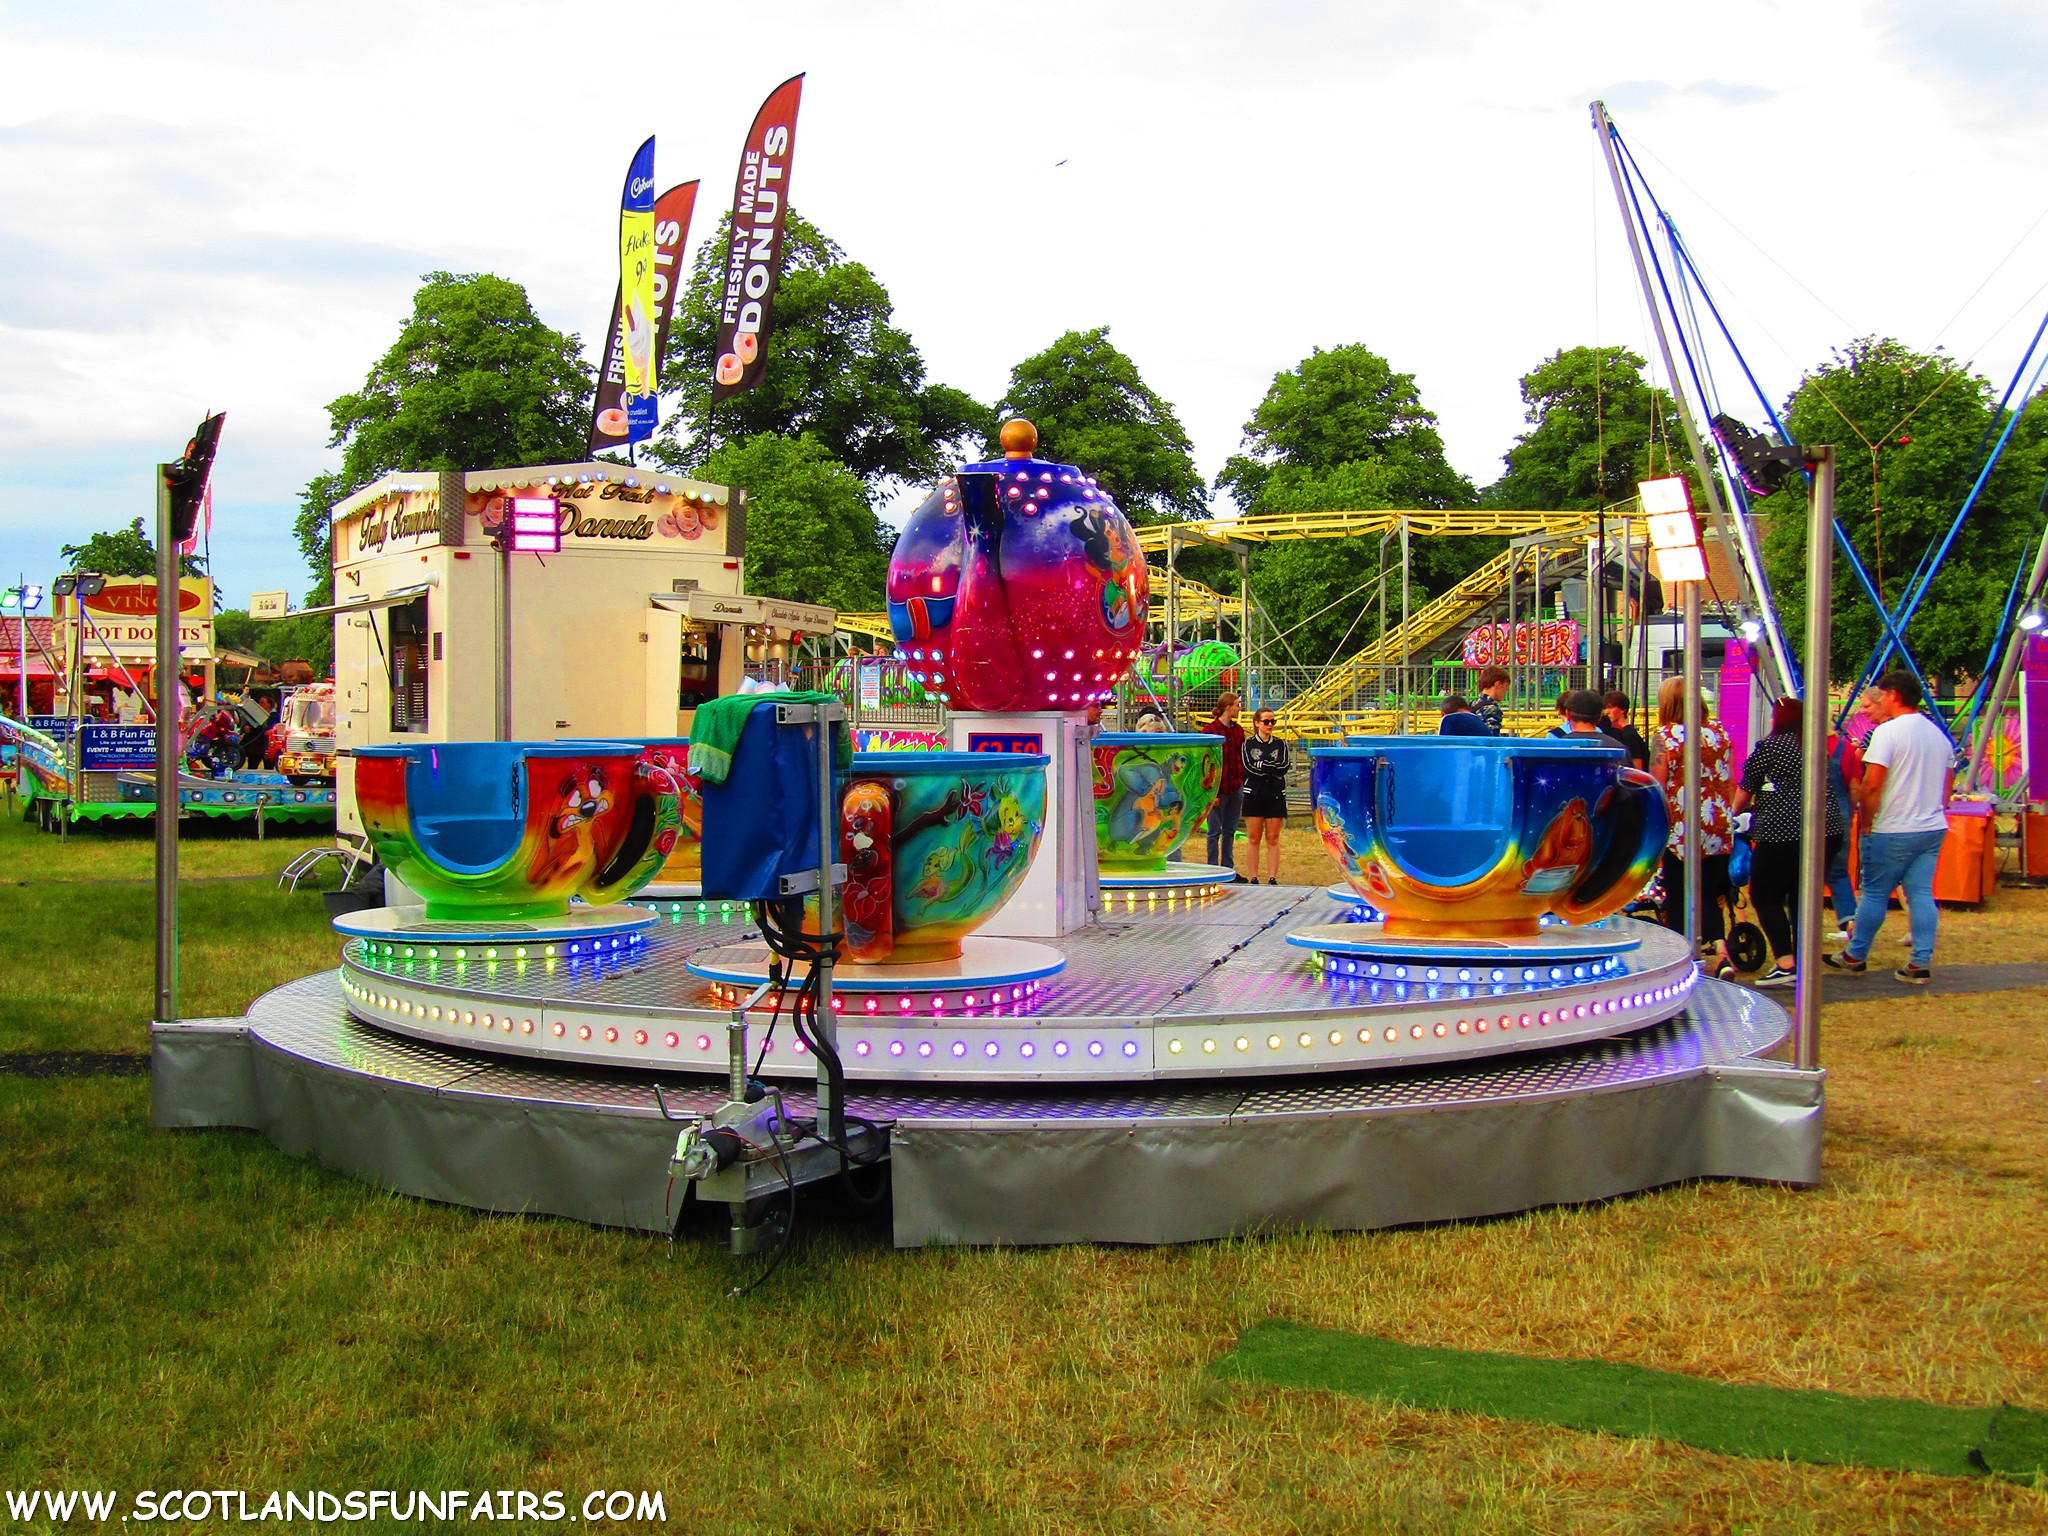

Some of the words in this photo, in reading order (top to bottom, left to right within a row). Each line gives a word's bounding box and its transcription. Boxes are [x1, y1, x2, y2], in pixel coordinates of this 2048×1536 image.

[724, 226, 749, 324] FRESHLY
[739, 151, 760, 214] MADE
[738, 125, 788, 333] DONUTS
[548, 483, 595, 499] Hot
[599, 483, 654, 504] Fresh
[560, 501, 654, 541] Donuts
[83, 627, 122, 640] HOT
[92, 730, 98, 738] L
[100, 730, 108, 738] &
[110, 730, 118, 738] B
[120, 729, 137, 739] Fun
